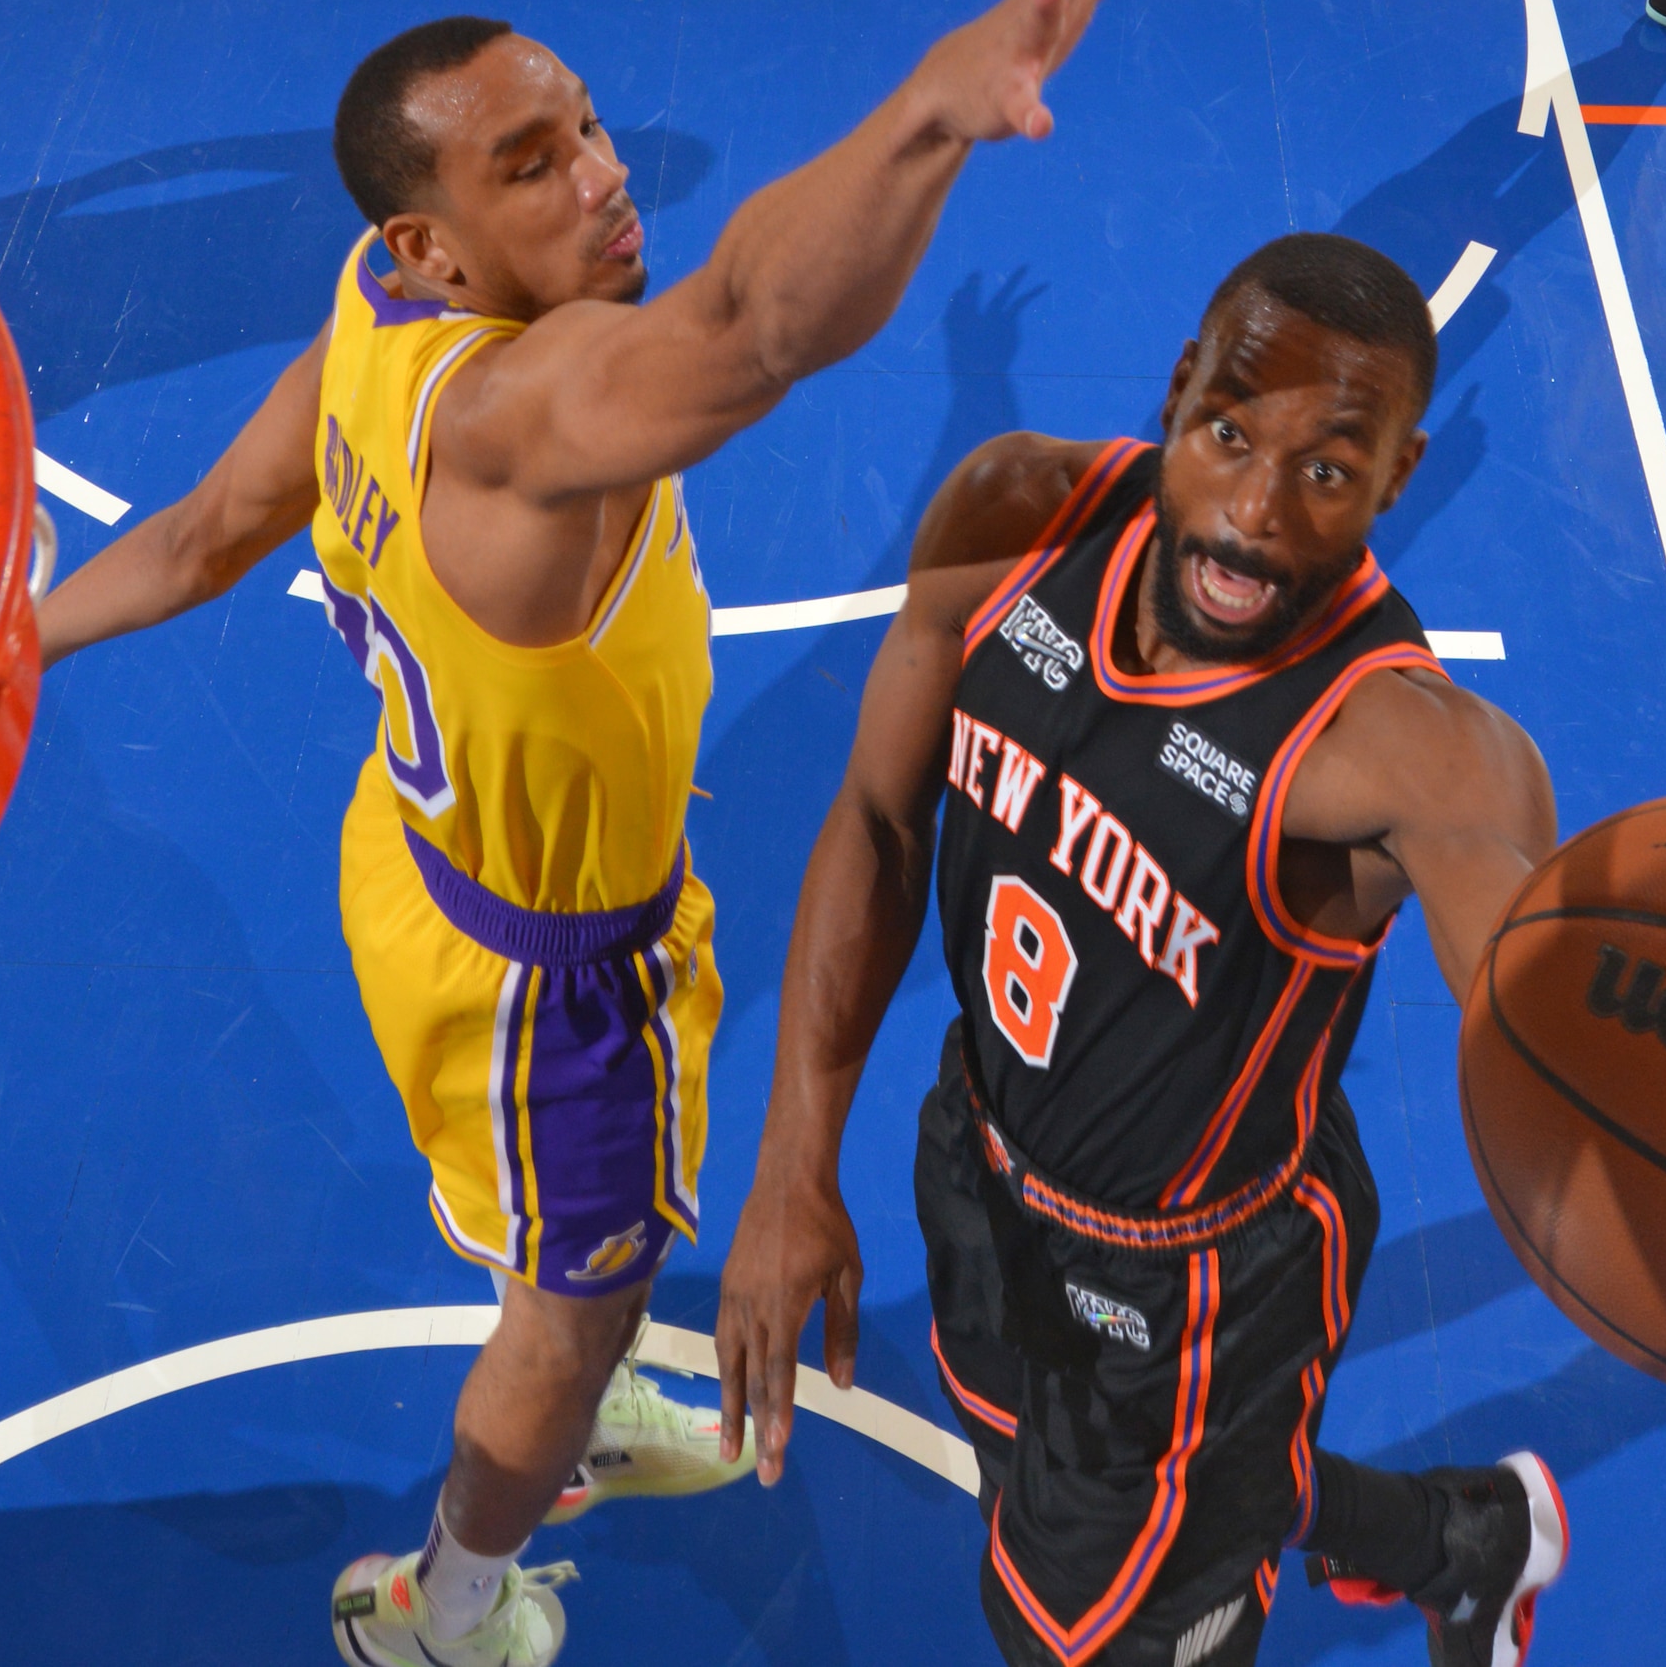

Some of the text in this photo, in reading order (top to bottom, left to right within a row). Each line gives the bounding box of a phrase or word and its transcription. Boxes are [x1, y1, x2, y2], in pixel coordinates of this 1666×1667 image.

[1158, 743, 1230, 807] SPACE
[1168, 722, 1257, 795] SQUARE
[947, 706, 1221, 1009] NEW YORK
[982, 874, 1079, 1071] 8
